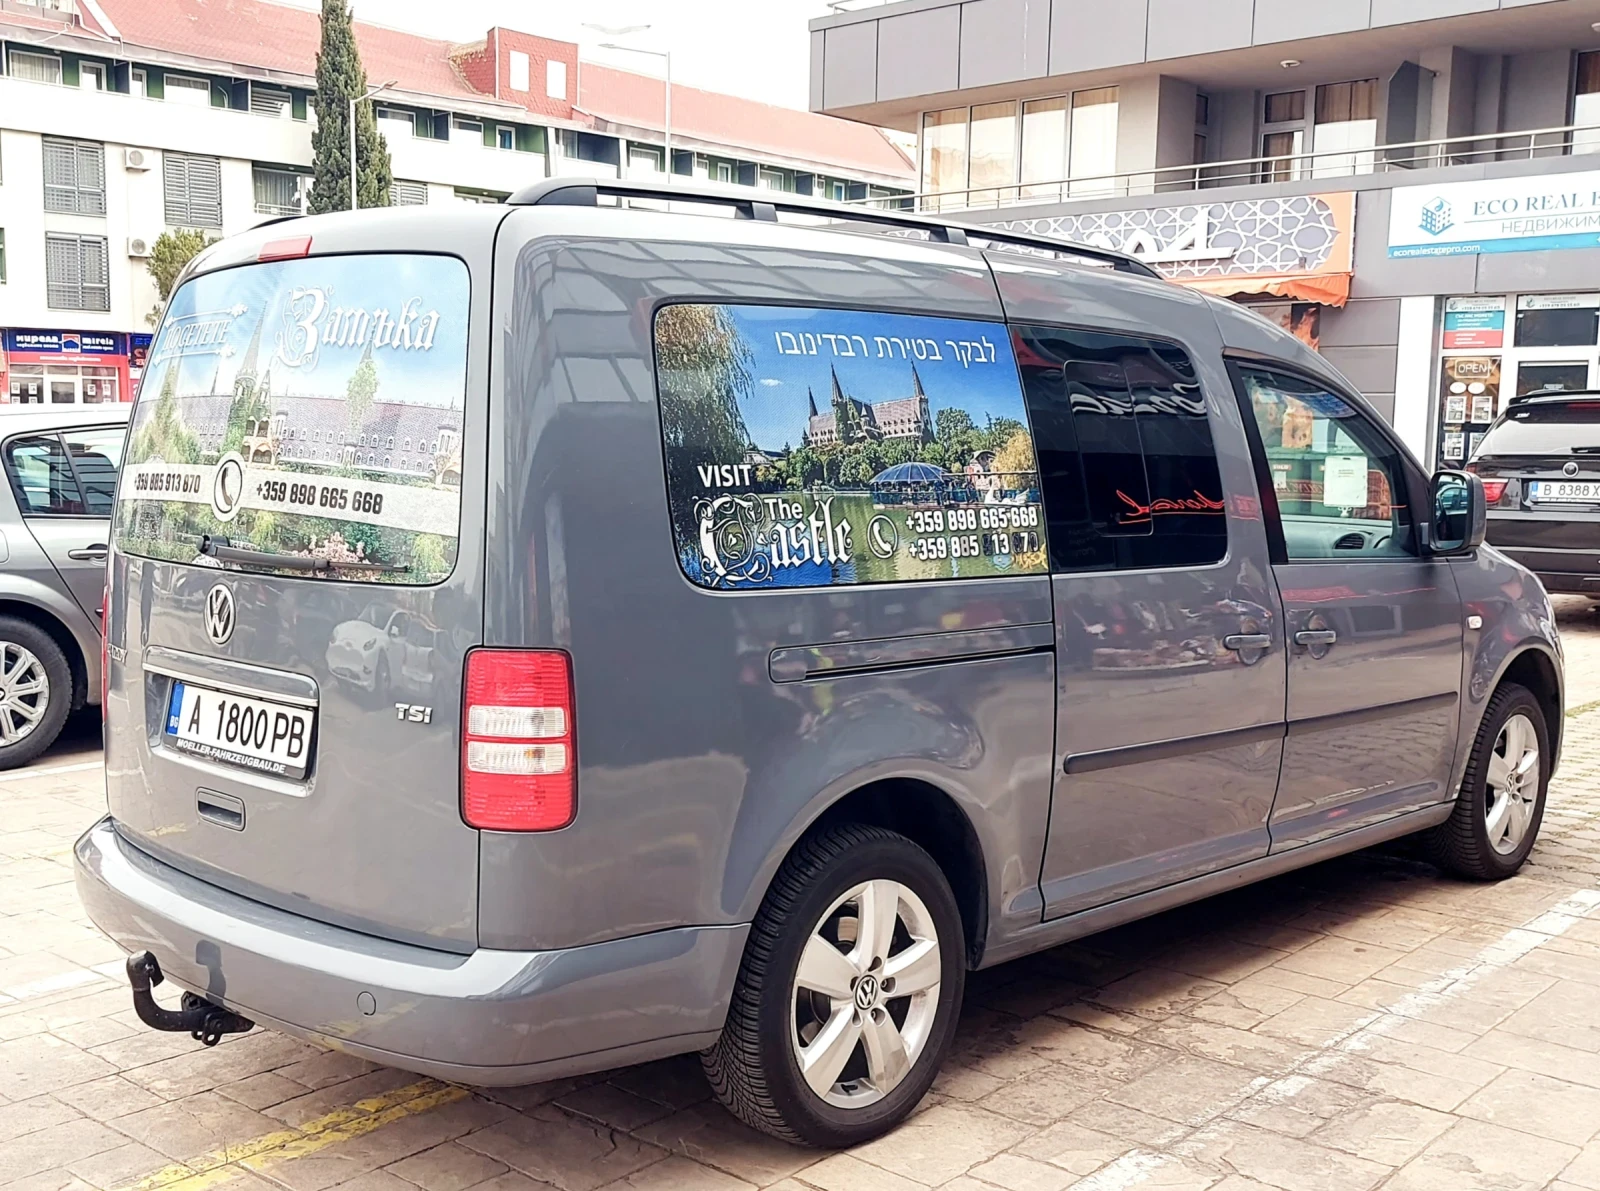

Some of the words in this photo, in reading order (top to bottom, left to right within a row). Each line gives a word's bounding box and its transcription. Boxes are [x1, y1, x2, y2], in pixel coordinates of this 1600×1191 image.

[1473, 198, 1519, 216] ECO
[1526, 192, 1584, 212] REAL
[1393, 244, 1481, 258] ecorealestatepro.com
[162, 319, 232, 351] ПОСЕТЕТЕ
[774, 330, 869, 357] רבדינובו
[873, 335, 943, 361] בטירת
[945, 335, 996, 368] לבקר
[1458, 362, 1488, 374] OPEN
[165, 473, 182, 492] 913
[697, 464, 752, 488] VISIT
[256, 480, 287, 502] +359
[289, 483, 317, 506] 898
[319, 486, 348, 510] 665
[352, 490, 383, 515] 668
[1543, 484, 1552, 496] B
[1558, 484, 1590, 496] 8388
[764, 497, 803, 522] The
[905, 510, 944, 533] +359
[947, 508, 977, 531] 898
[979, 507, 1008, 530] 665
[1010, 506, 1038, 528] 668
[692, 492, 852, 588] Castle
[908, 536, 947, 561] +359
[951, 534, 979, 558] 885
[983, 532, 1010, 556] 13
[169, 715, 179, 728] BG
[188, 695, 201, 735] A
[216, 700, 268, 750] 1800
[270, 712, 305, 759] PB
[176, 738, 287, 774] MOELLER-FAHRZEUGBAU.DE
